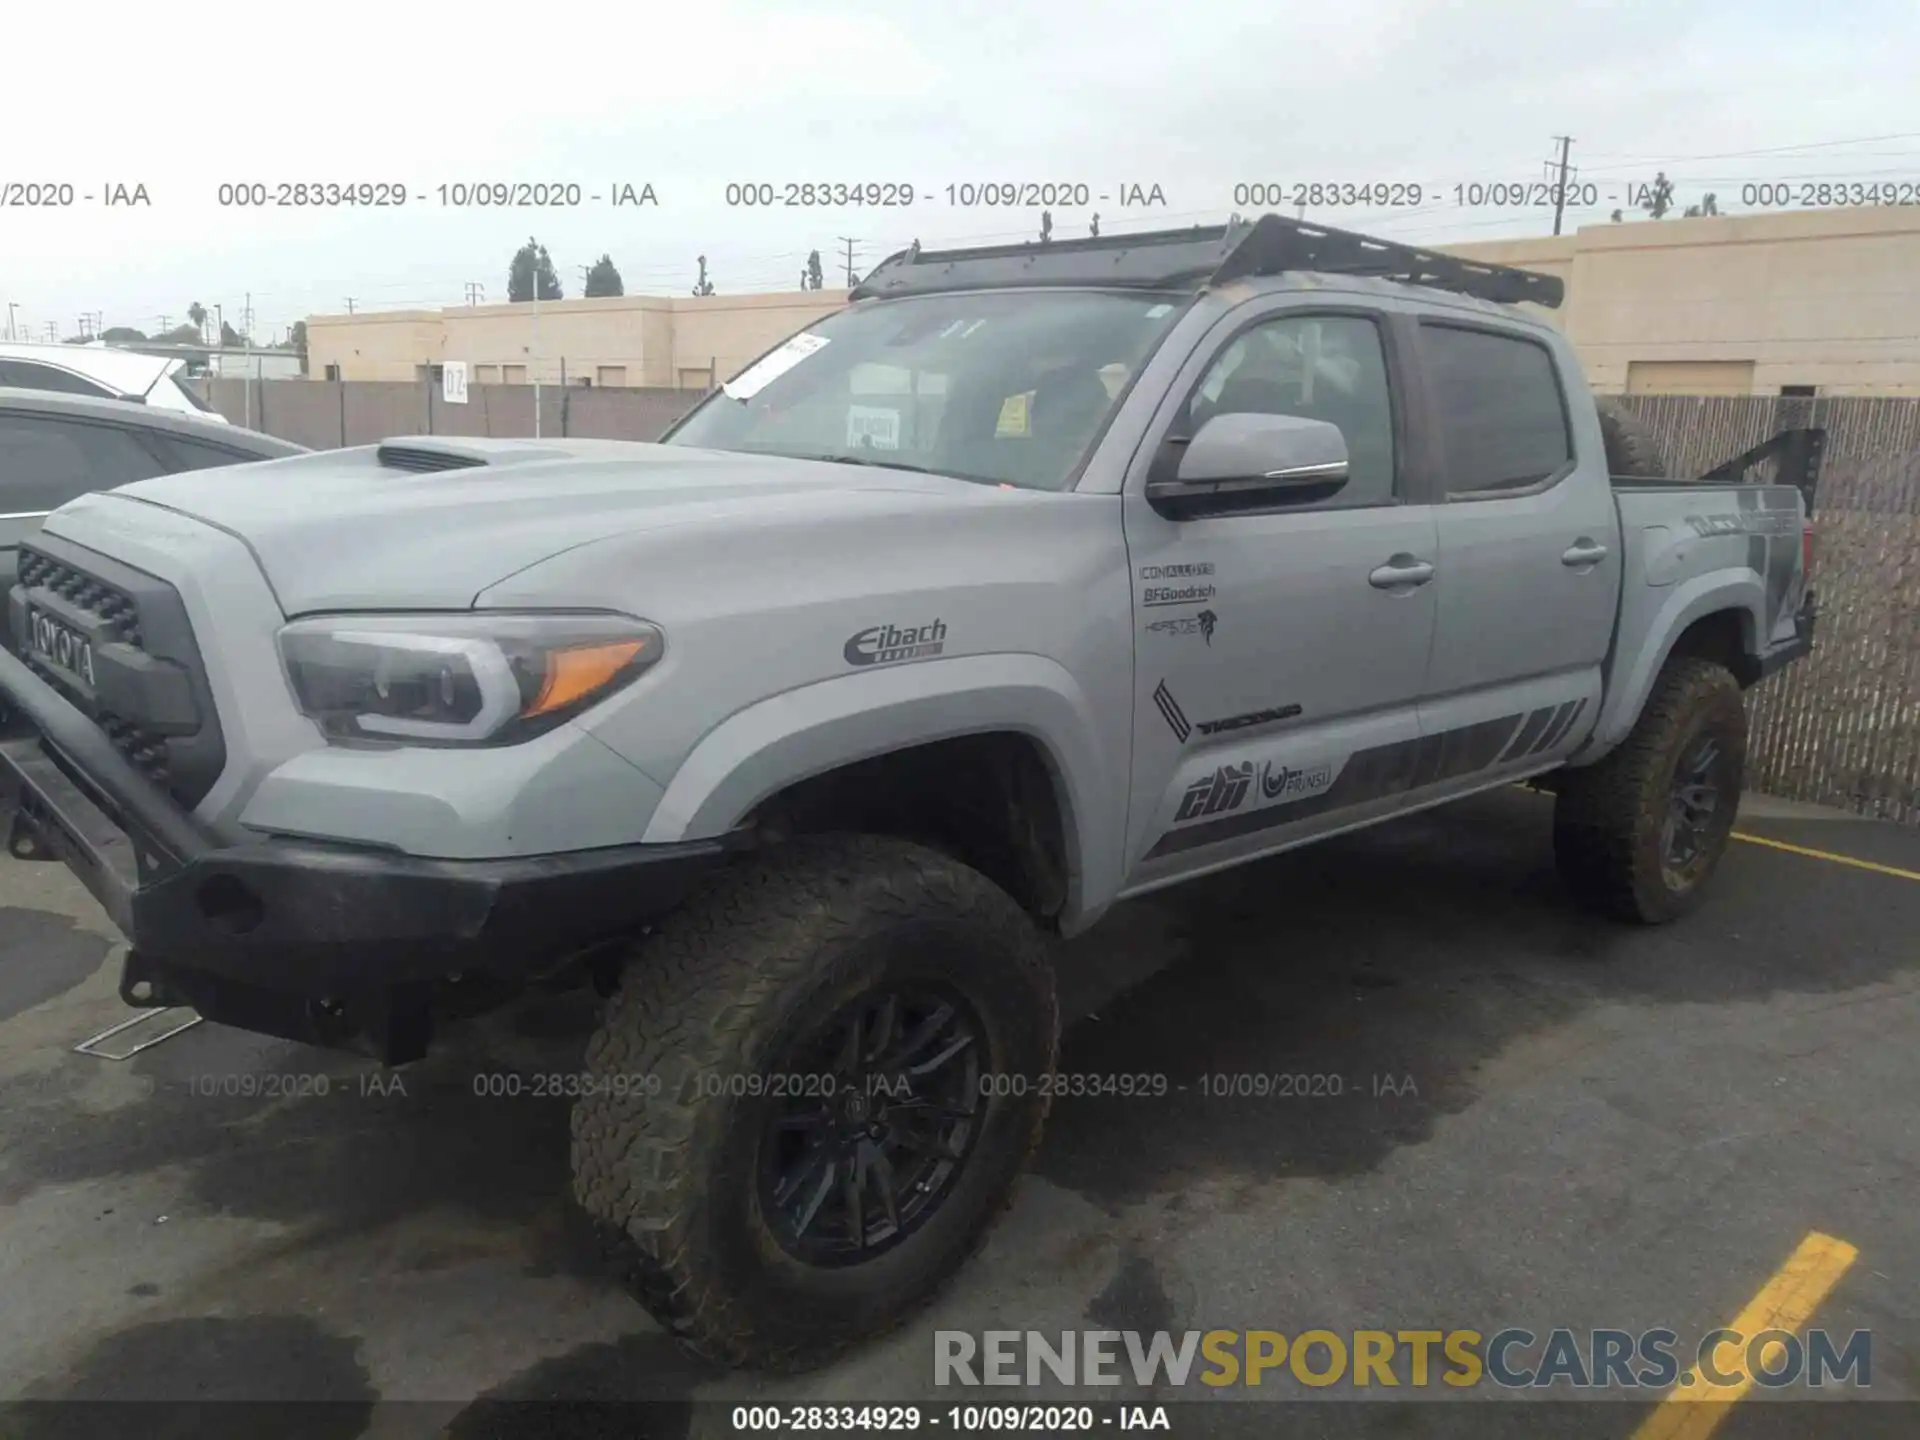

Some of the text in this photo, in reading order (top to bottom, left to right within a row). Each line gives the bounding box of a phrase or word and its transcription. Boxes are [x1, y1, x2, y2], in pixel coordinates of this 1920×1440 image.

[1143, 583, 1216, 602] BFGoodrich
[30, 611, 95, 686] TOYOTA
[843, 617, 947, 665] Eibach
